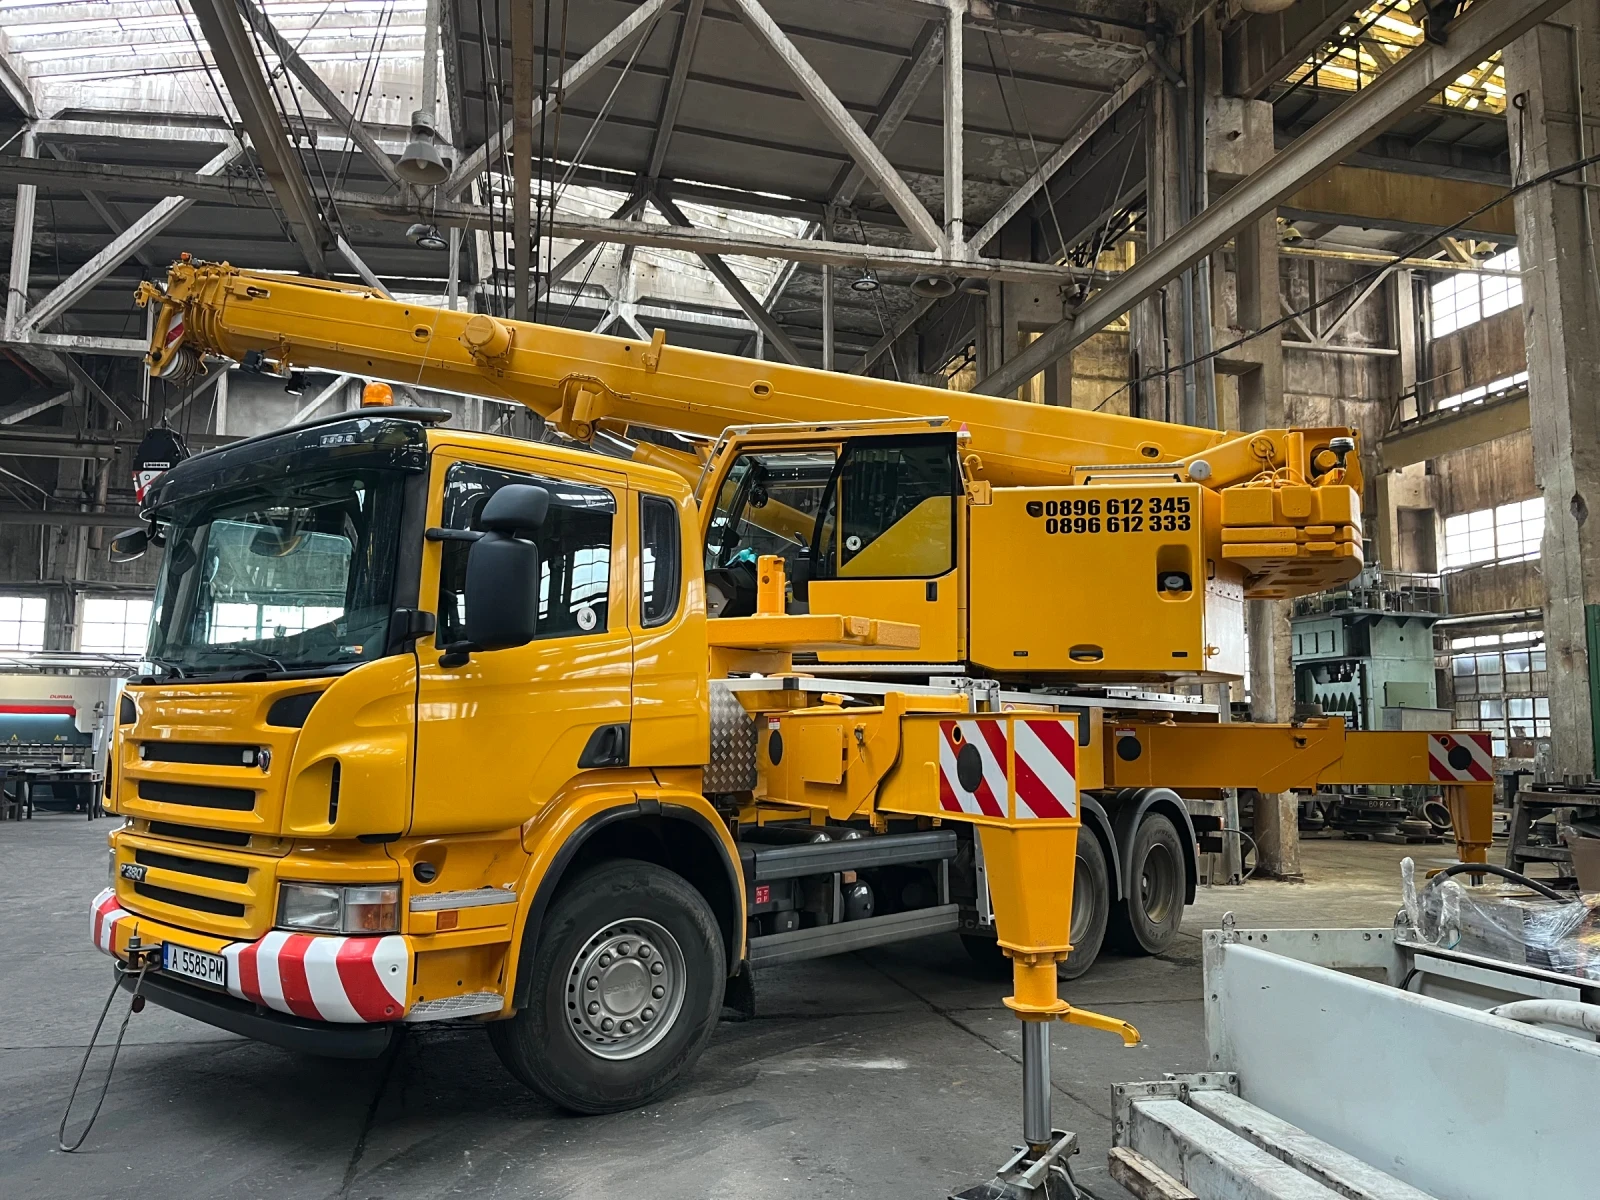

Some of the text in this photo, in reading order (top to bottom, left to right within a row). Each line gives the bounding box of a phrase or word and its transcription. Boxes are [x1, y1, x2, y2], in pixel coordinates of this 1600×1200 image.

[1045, 496, 1191, 517] 0896 612 345
[1045, 515, 1191, 534] 0896 612 333
[172, 948, 223, 982] A 5585 PM
